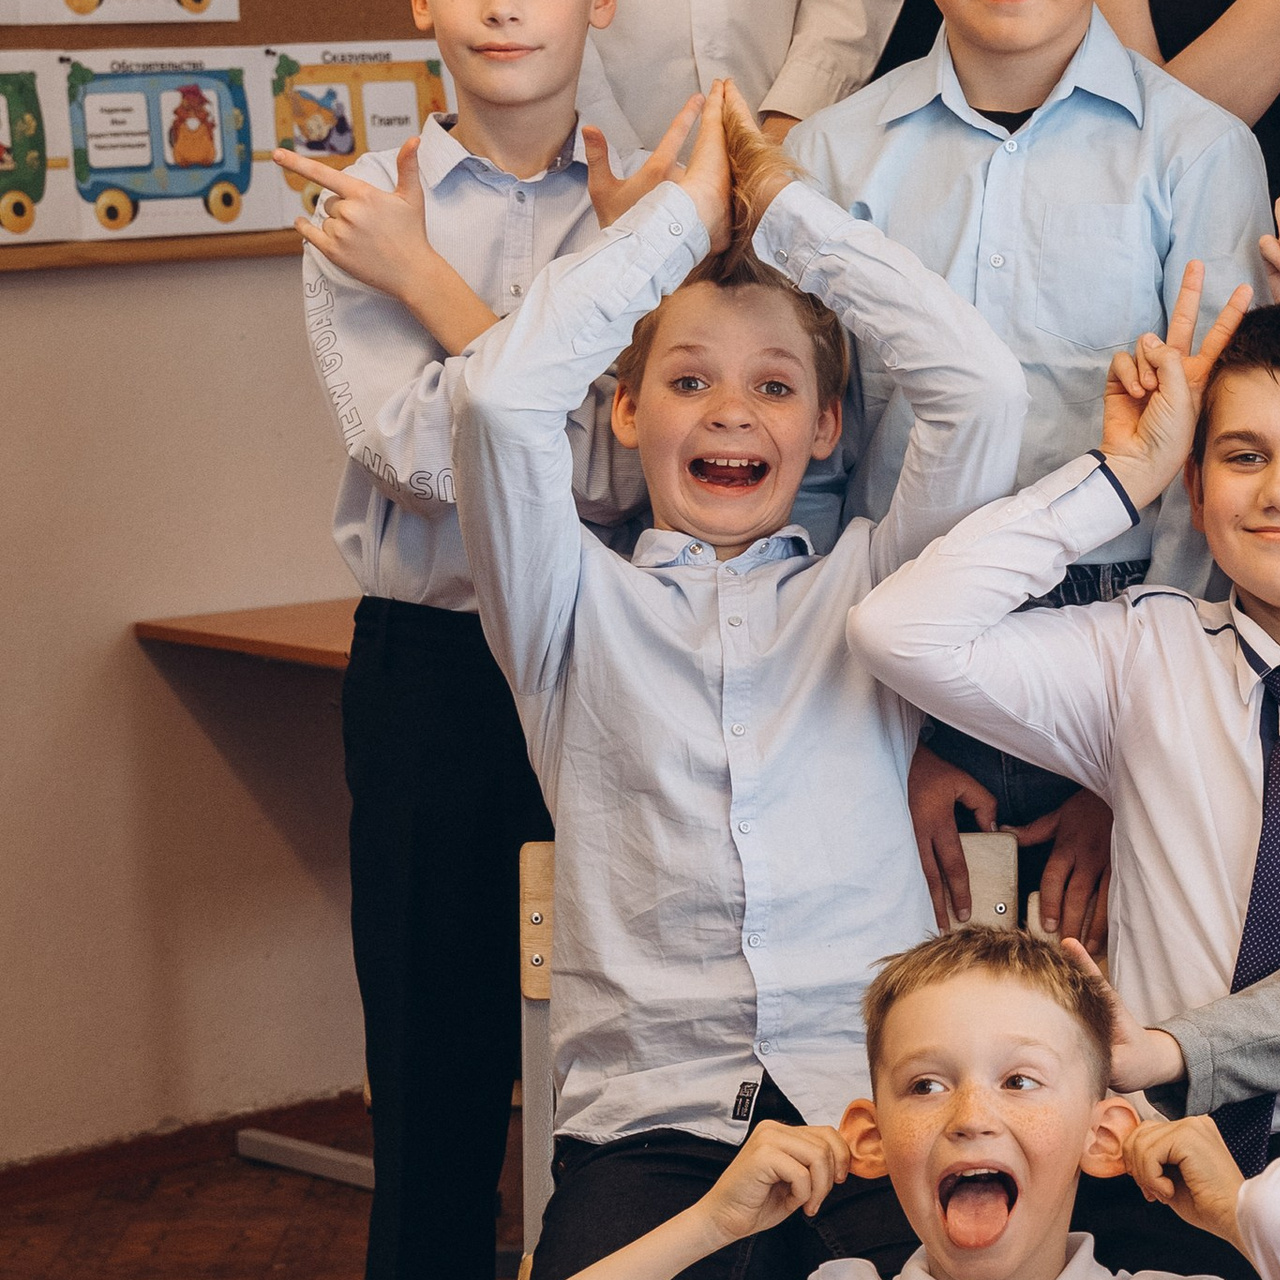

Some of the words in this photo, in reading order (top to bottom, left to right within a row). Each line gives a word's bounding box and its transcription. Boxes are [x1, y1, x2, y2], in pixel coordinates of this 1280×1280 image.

[321, 51, 393, 65] Сказуемое
[110, 59, 206, 73] Обстоятельство
[370, 114, 411, 127] Глагол
[304, 272, 344, 380] GOALS
